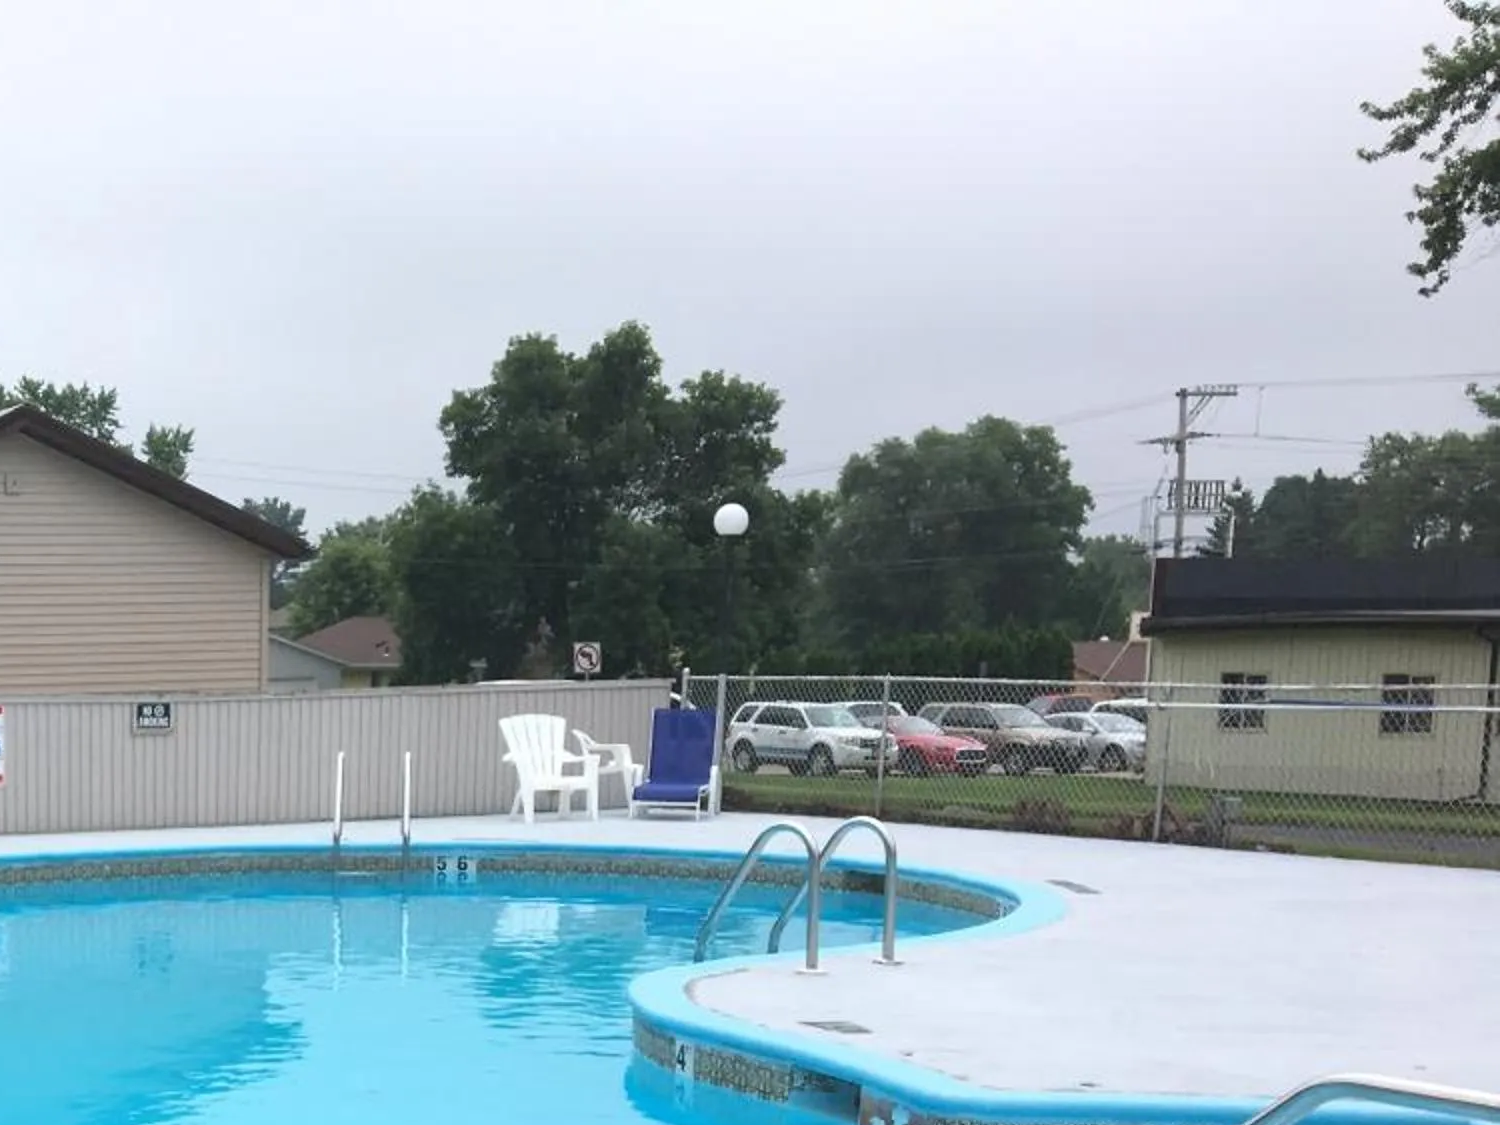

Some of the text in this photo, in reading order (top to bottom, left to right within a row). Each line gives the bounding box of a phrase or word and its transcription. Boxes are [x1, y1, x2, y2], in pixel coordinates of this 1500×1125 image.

[437, 854, 468, 871] 5 6
[676, 1043, 686, 1072] 4
